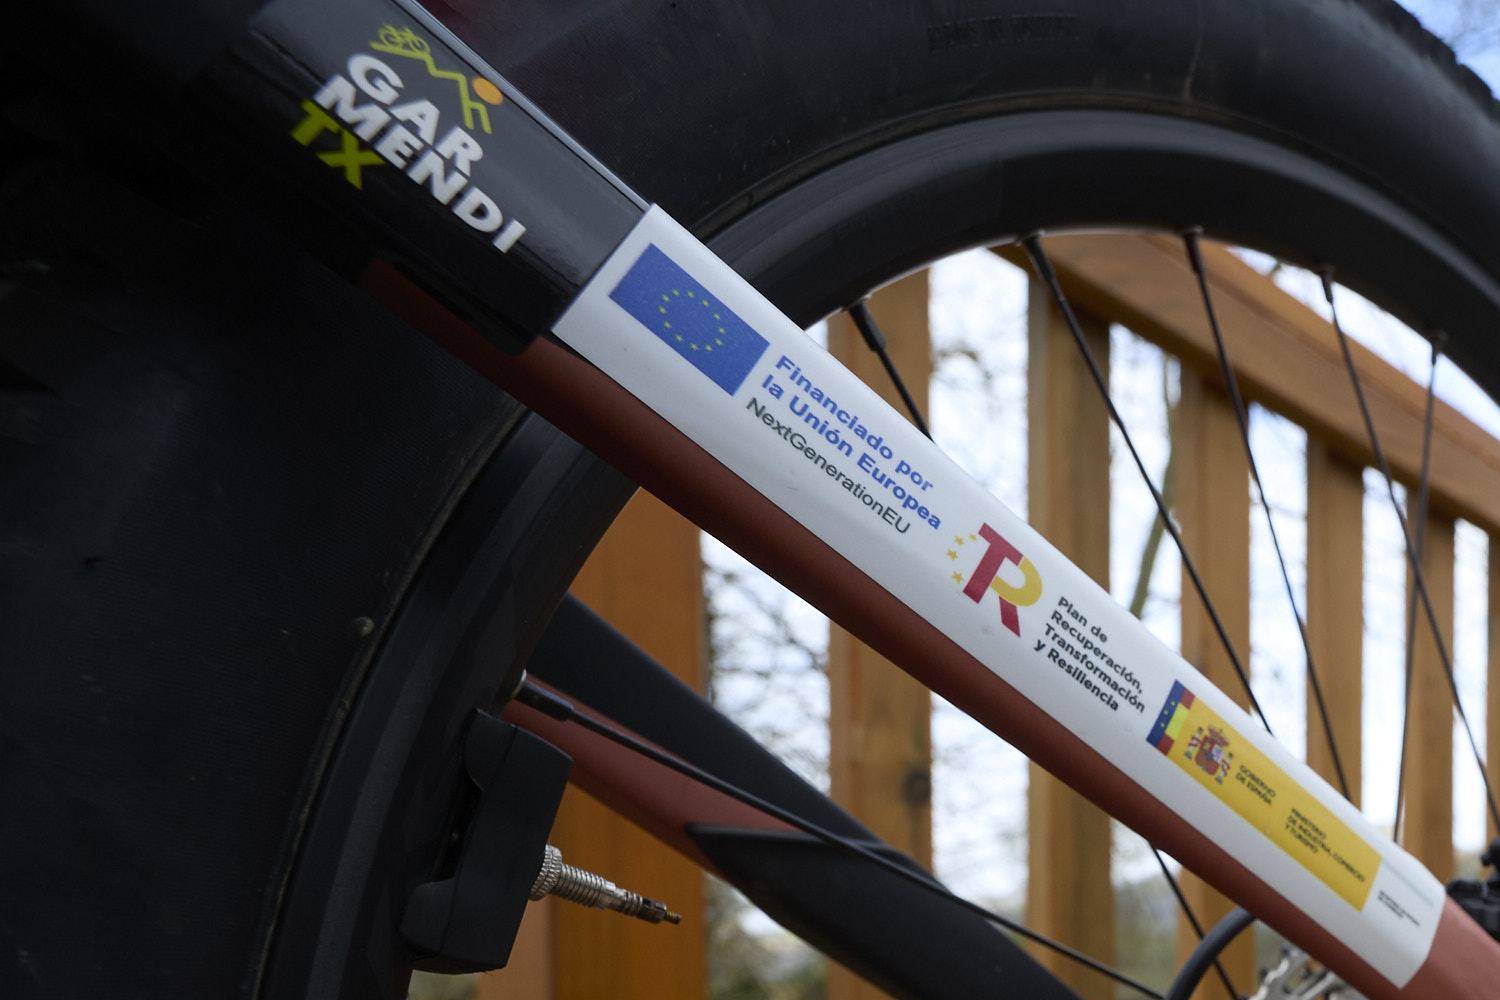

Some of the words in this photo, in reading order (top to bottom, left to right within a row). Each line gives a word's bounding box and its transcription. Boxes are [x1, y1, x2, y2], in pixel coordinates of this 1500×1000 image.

[290, 98, 386, 190] TX
[347, 53, 484, 177] GAR
[313, 74, 527, 253] MENDI
[746, 397, 910, 533] NextGenerationEU
[761, 374, 784, 400] la
[789, 395, 853, 457] Unión
[856, 452, 941, 530] Europea
[775, 355, 893, 460] Financiado
[895, 460, 933, 492] por
[1051, 610, 1144, 694] Recuperación,
[1058, 596, 1088, 627] Plan
[1090, 622, 1108, 643] de
[1033, 639, 1046, 652] y
[1048, 648, 1120, 712] Resiliencia
[1043, 623, 1146, 714] Transformación
[1239, 764, 1276, 798] GOBIERNO
